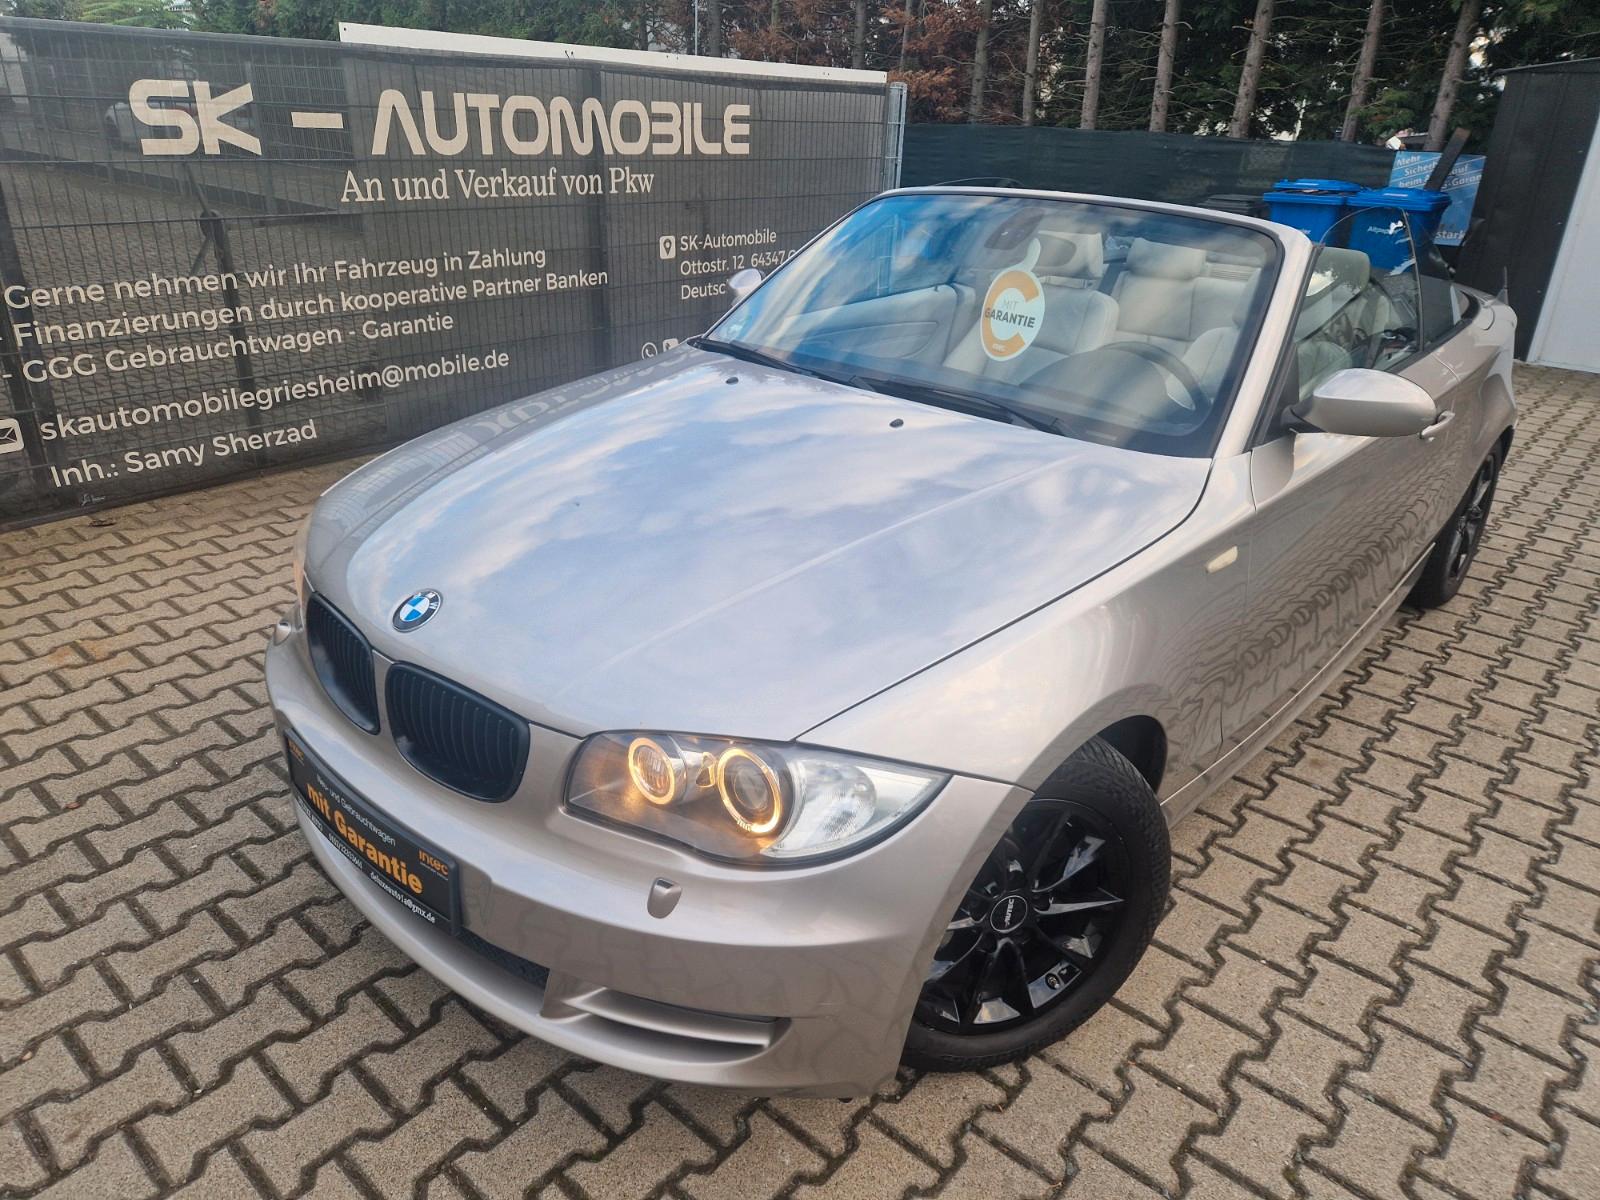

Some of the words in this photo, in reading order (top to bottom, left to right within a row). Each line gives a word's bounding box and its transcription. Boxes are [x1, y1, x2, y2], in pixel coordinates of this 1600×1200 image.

[128, 78, 262, 156] SK
[371, 88, 751, 156] AUTOMOBILE
[340, 170, 387, 203] An
[392, 168, 450, 201] und
[454, 167, 557, 199] Verkauf
[561, 173, 602, 196] von
[608, 166, 655, 194] Pkw
[680, 228, 777, 252] SK-Automobile
[680, 257, 730, 276] Ottostr.
[732, 254, 745, 270] 12
[751, 250, 785, 267] 64347
[4, 283, 105, 309] Gerne
[113, 272, 238, 300] nehmen
[244, 264, 287, 288] wir
[293, 262, 328, 285] Ihr
[334, 257, 438, 281] Fahrzeug
[443, 251, 463, 272] in
[467, 247, 546, 270] Zahlung
[12, 305, 253, 348] Finanzierungen
[259, 292, 335, 320] durch
[340, 282, 467, 312] kooperative
[472, 275, 542, 299] Partner
[546, 269, 609, 290] Banken
[681, 280, 729, 300] Deutsc
[22, 353, 98, 383] GGG
[105, 326, 342, 373] Gebrauchtwagen
[362, 311, 454, 340] Garantie
[984, 307, 1036, 329] GARANTIE
[40, 348, 511, 441] skautomobilegriesheim@mobile.de
[50, 457, 119, 488] Inh.:
[124, 443, 205, 474] Samy
[212, 418, 318, 457] Sherzad
[306, 783, 332, 821] mit
[334, 809, 424, 894] Garantie
[340, 798, 396, 847] Gebrauchtwagen
